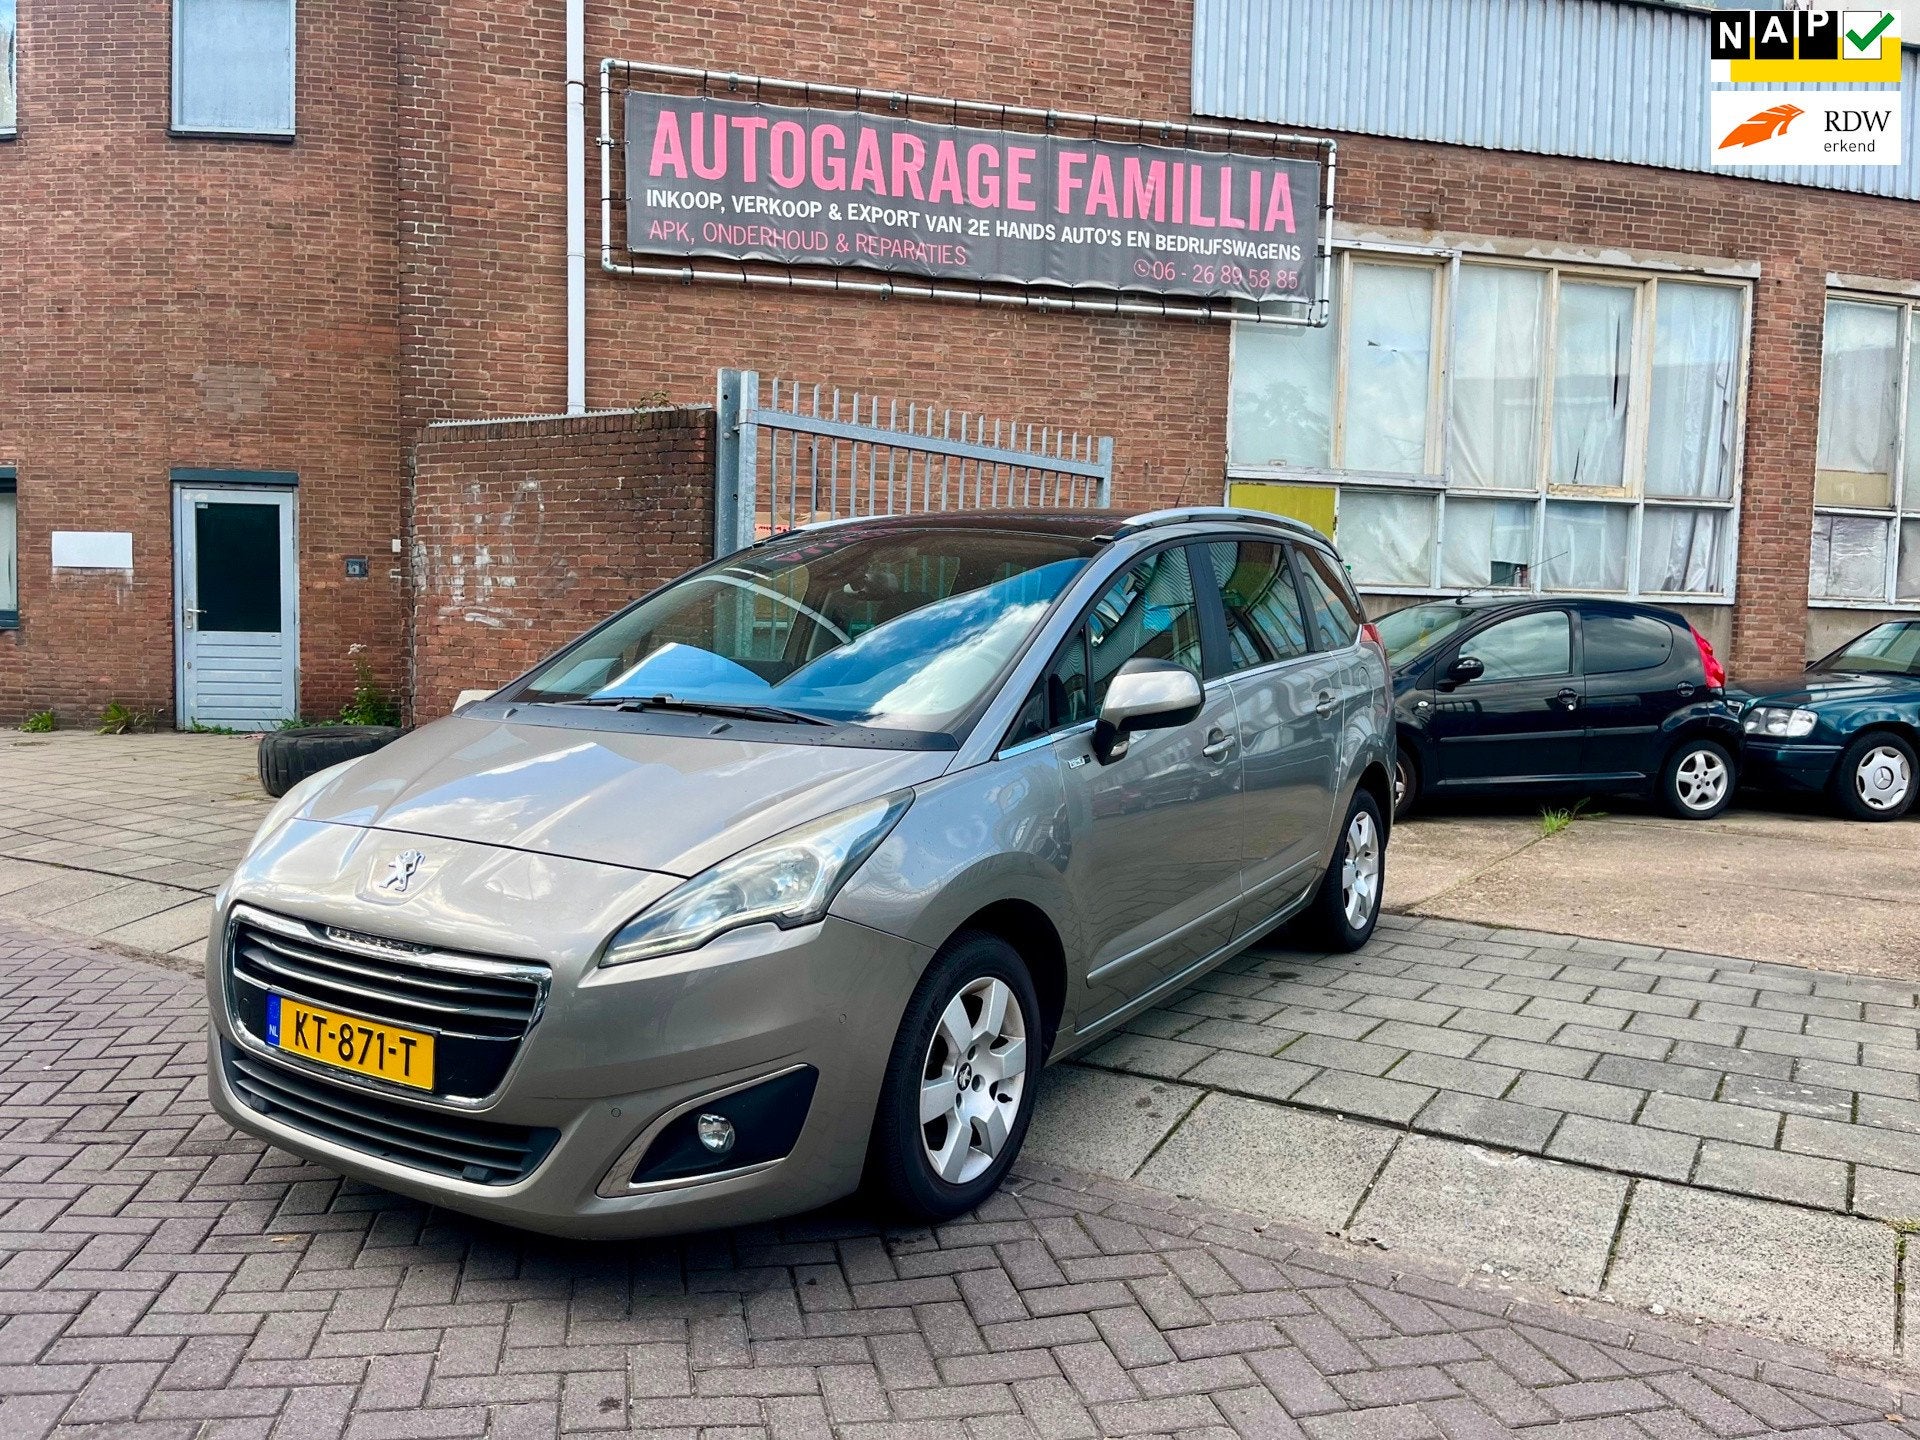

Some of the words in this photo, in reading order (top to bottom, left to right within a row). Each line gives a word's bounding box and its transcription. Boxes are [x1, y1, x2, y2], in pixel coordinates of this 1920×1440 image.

[649, 110, 1036, 212] AUTOGARAGE
[1058, 151, 1297, 234] FAMILLIA
[646, 189, 726, 214] INKOOP,
[731, 195, 822, 219] VERKOOP
[828, 202, 843, 220] &
[848, 203, 921, 229] EXPORT
[925, 214, 963, 235] VAN
[967, 219, 990, 237] 2E
[996, 220, 1056, 241] HANDS
[1060, 226, 1122, 247] AUTO'S
[1127, 231, 1151, 249] EN
[1155, 233, 1301, 262] BEDRIJFSWAGENS
[649, 220, 695, 245] APK,
[703, 221, 829, 250] ONDERHOUD
[836, 233, 850, 253] &
[856, 235, 967, 266] REPARATIES
[1153, 260, 1176, 281] 06
[1193, 264, 1215, 284] 26
[1220, 264, 1243, 285] 89
[1249, 268, 1270, 288] 58
[1276, 269, 1298, 290] 85
[269, 1023, 279, 1038] NL
[295, 1009, 418, 1077] KT-871-T
